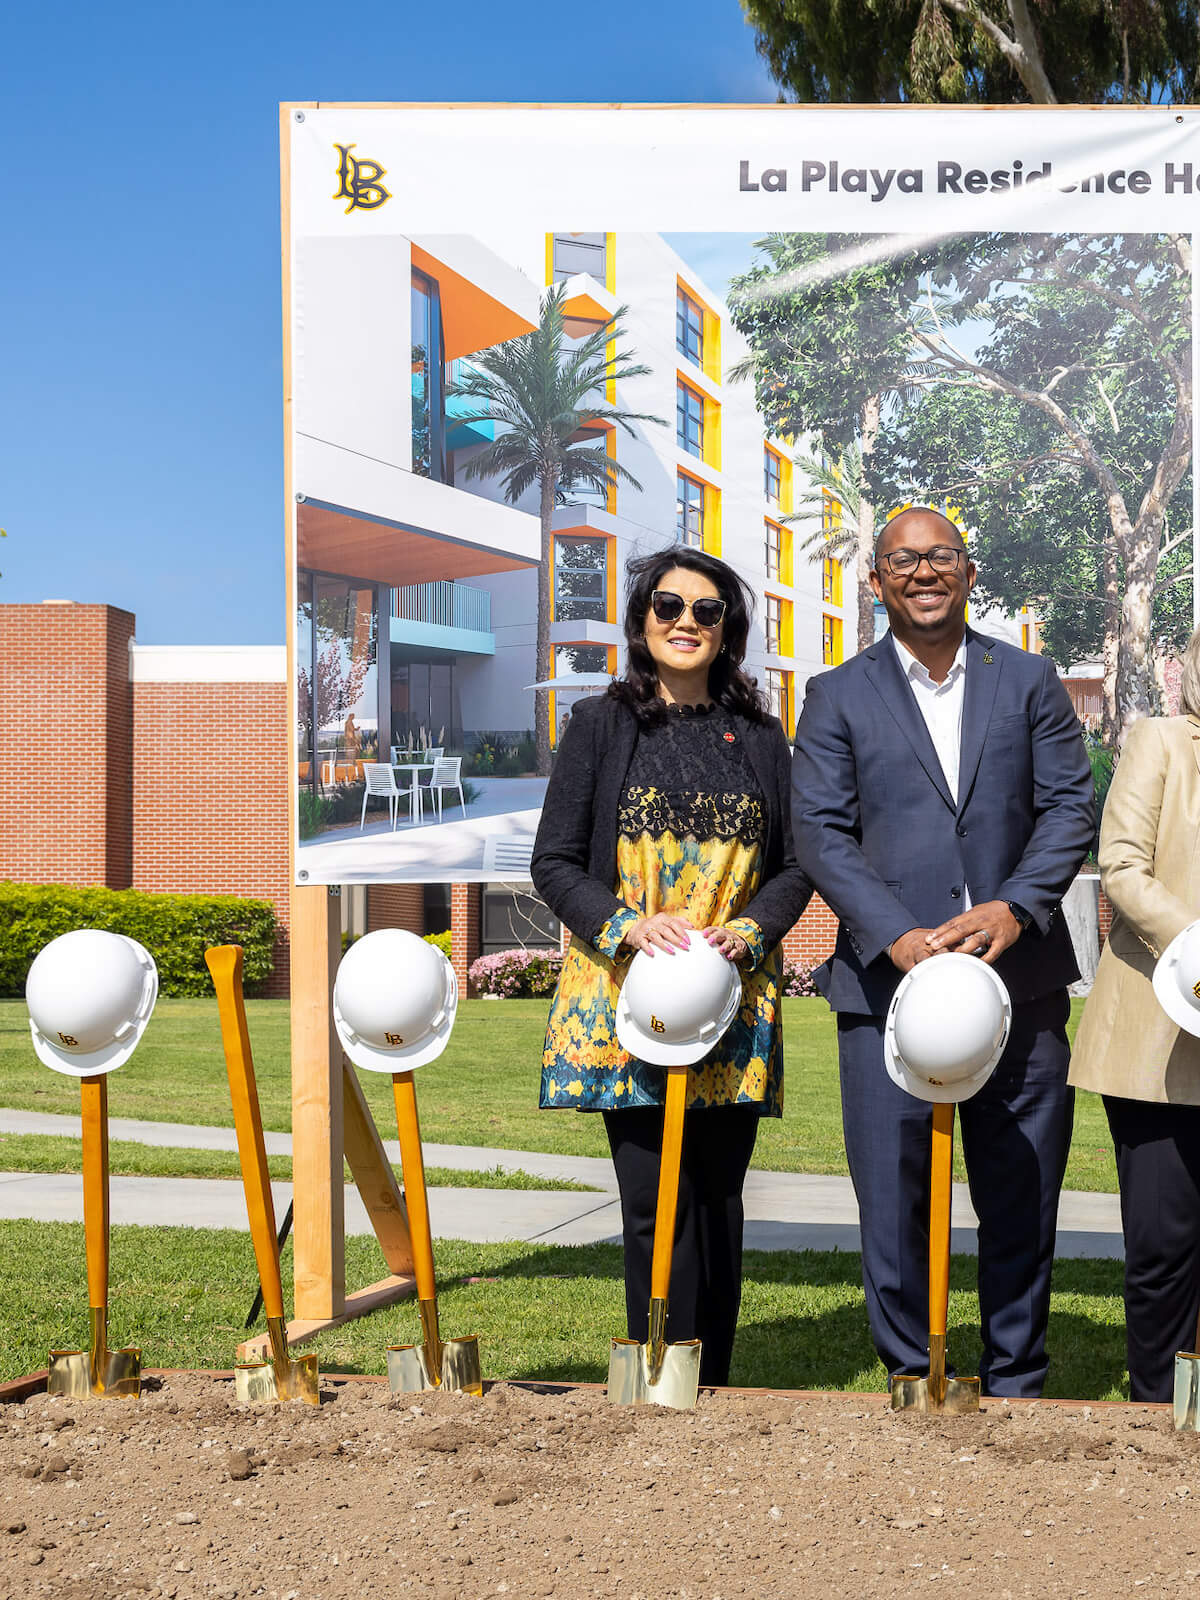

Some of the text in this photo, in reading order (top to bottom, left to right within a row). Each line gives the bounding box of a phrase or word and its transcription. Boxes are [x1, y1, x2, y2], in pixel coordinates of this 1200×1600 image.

[332, 143, 393, 215] LB
[739, 159, 788, 193] La
[801, 160, 924, 203] Playa
[937, 159, 1152, 195] Residnce
[651, 1015, 666, 1034] LB
[57, 1031, 79, 1046] LB
[383, 1031, 404, 1046] LB
